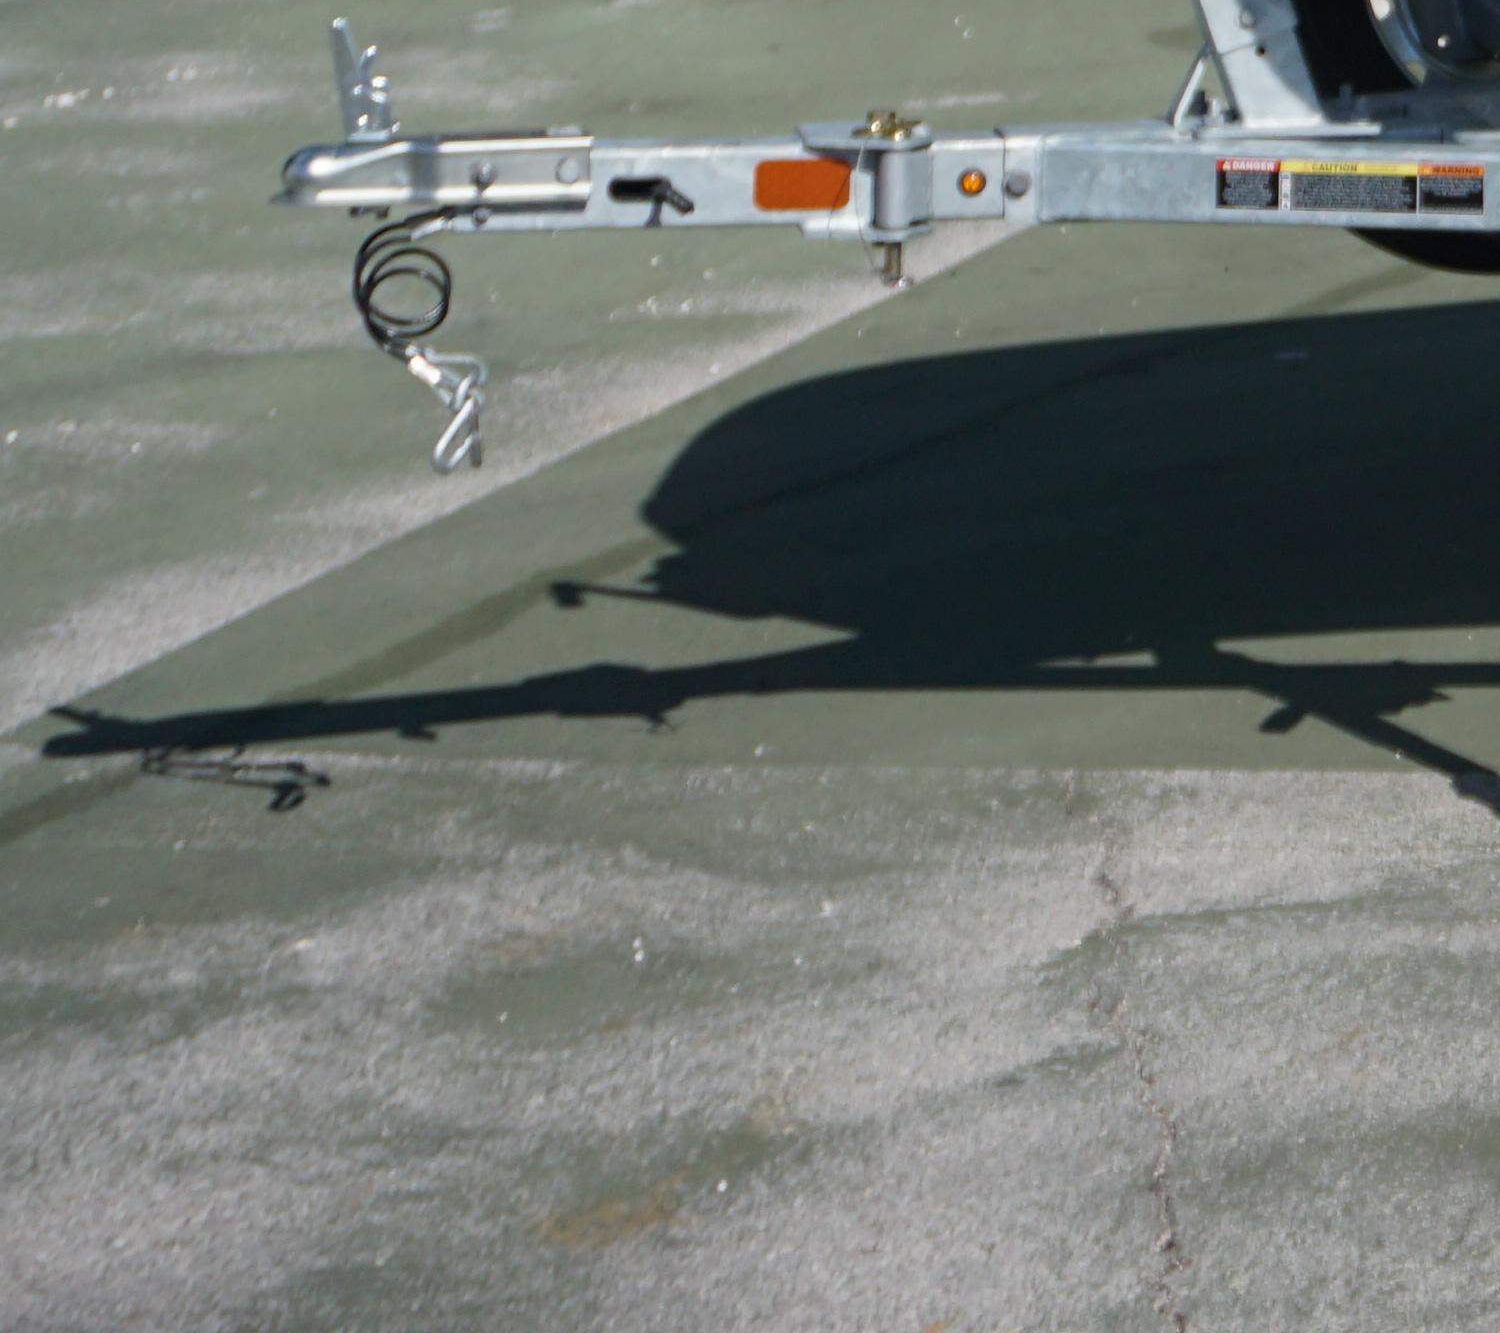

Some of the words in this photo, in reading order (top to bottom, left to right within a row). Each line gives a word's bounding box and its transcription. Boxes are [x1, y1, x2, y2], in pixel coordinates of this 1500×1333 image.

[1232, 160, 1275, 171] DANGER
[1312, 164, 1358, 172] CAUTION
[1432, 166, 1480, 175] WARNING
